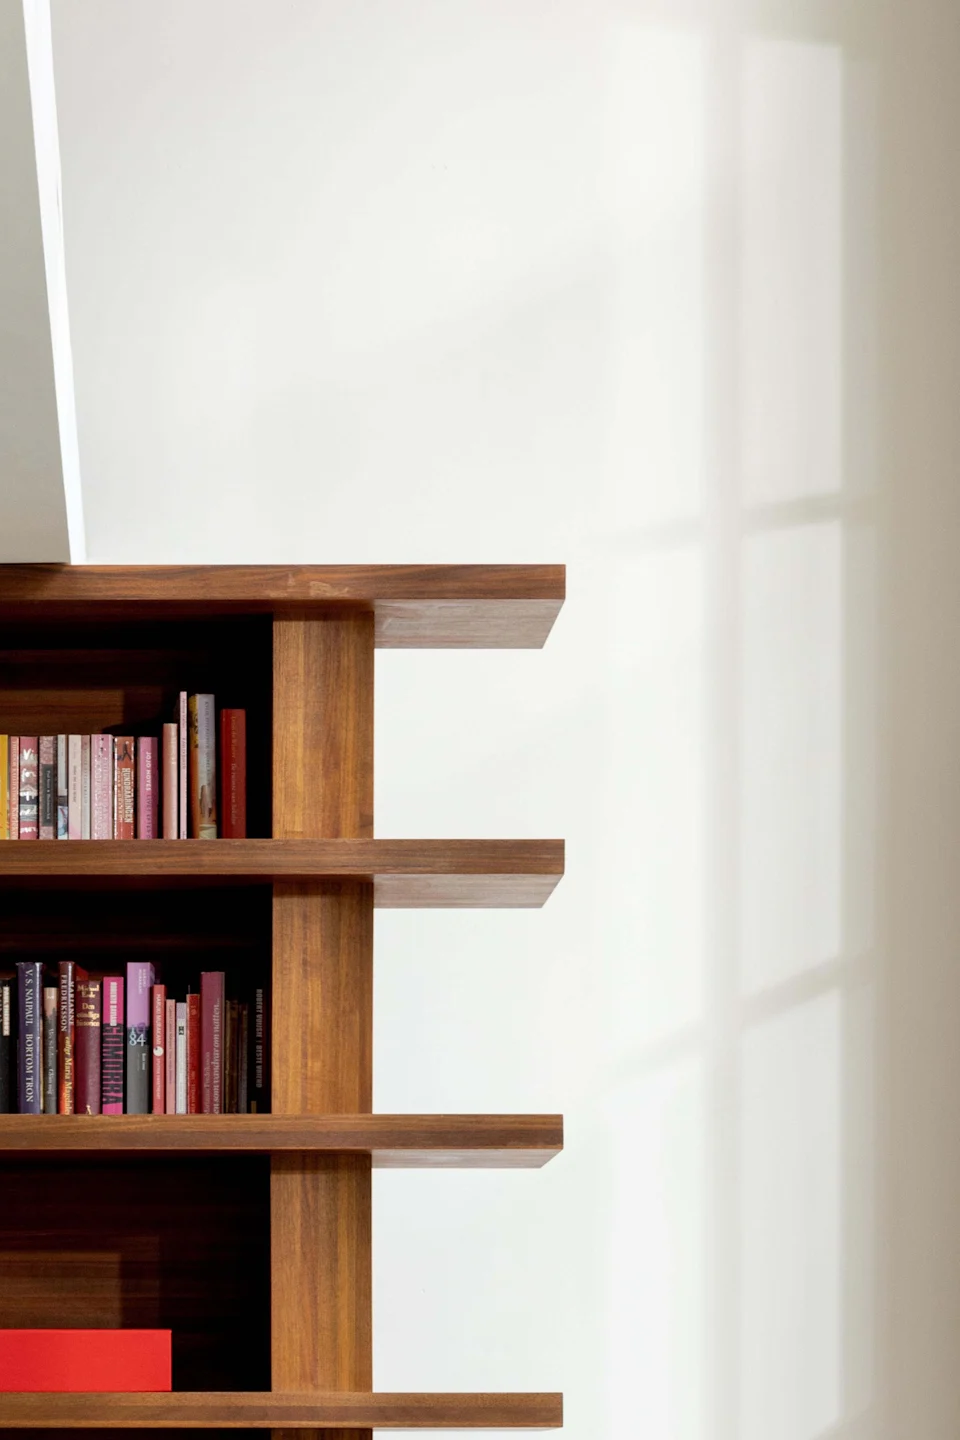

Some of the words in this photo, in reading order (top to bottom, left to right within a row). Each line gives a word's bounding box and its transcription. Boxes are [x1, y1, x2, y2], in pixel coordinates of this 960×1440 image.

[25, 988, 34, 1026] NAIPAUL
[25, 1034, 34, 1073] BORTOM
[130, 1034, 146, 1046] 84
[213, 1034, 220, 1048] om
[103, 1023, 124, 1104] GOMORRA
[210, 1048, 220, 1084] vandrar
[25, 1075, 34, 1102] TRON
